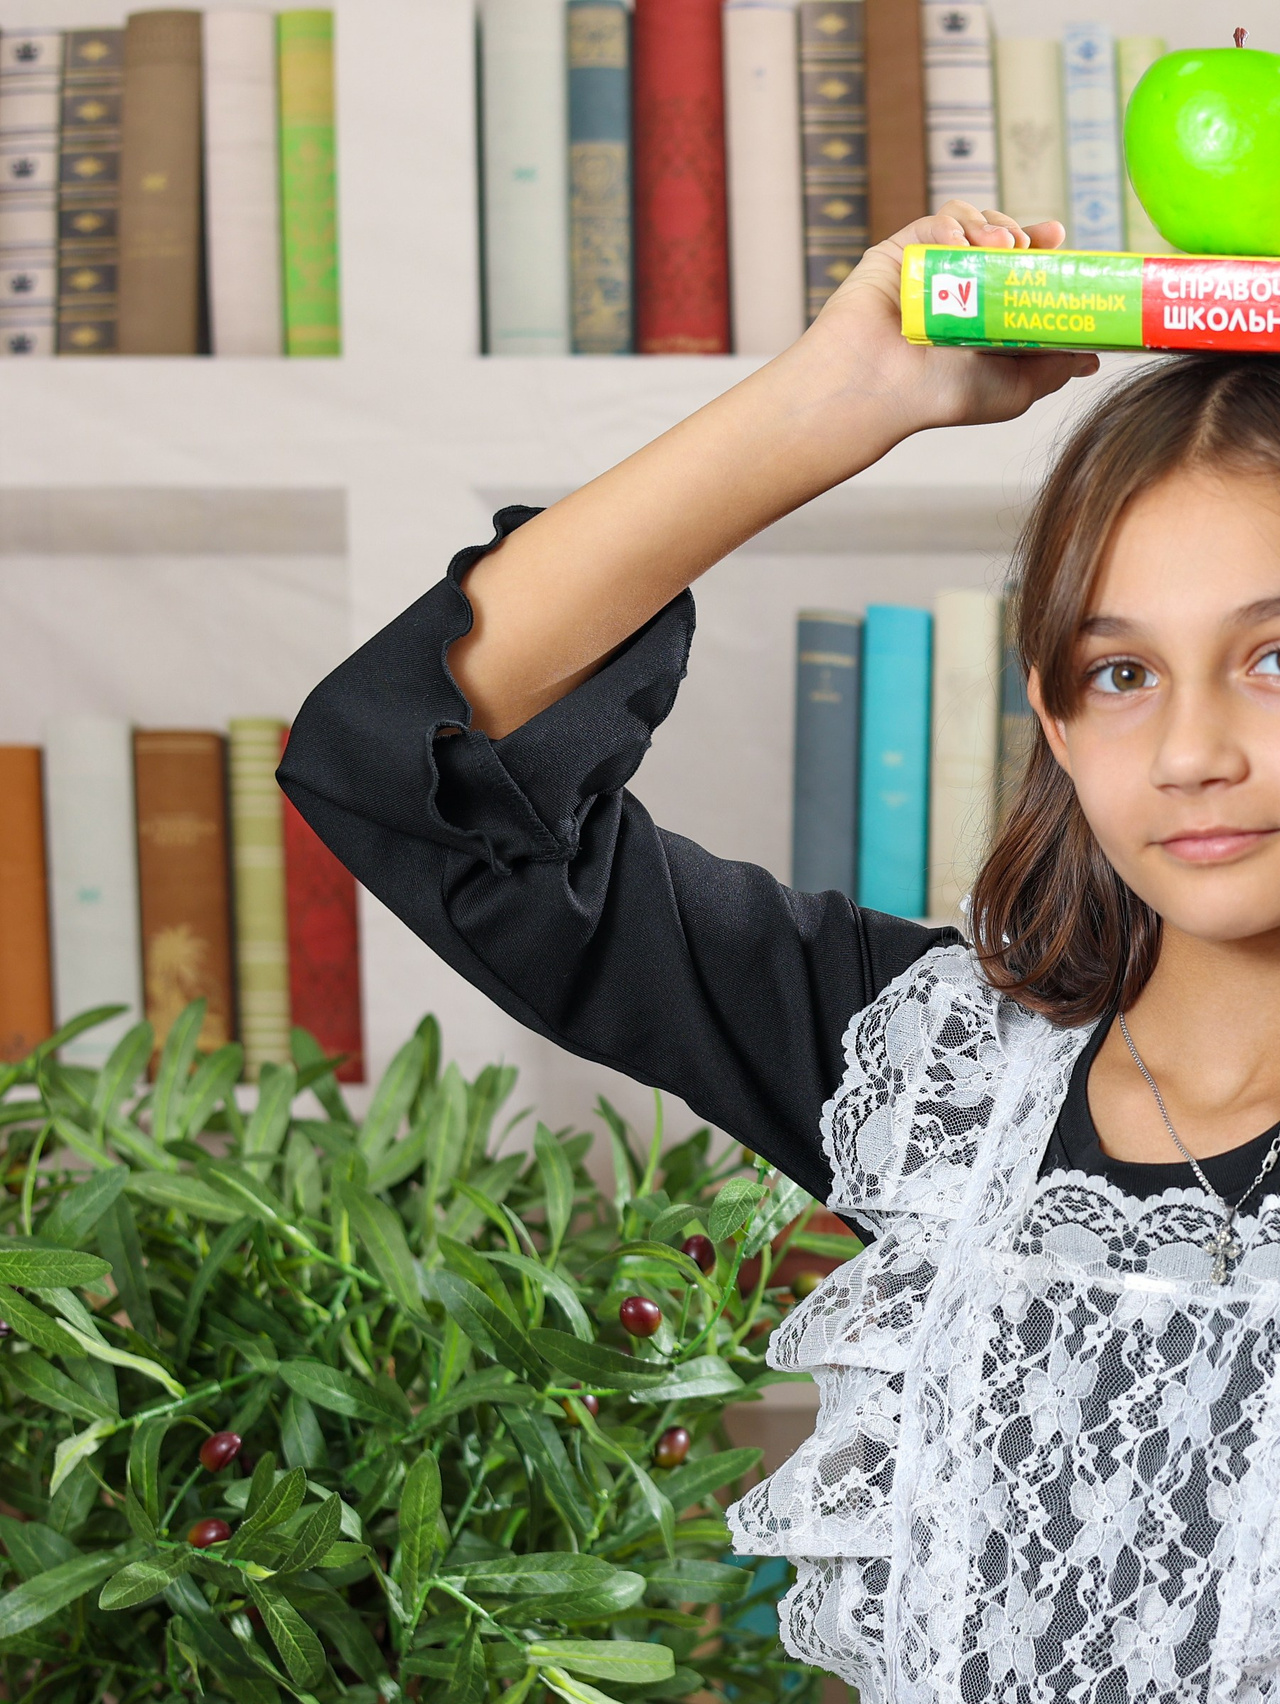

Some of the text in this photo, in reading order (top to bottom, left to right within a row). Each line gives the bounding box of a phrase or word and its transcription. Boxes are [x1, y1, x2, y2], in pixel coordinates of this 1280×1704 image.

[1003, 269, 1047, 287] ДЛЯ
[1003, 289, 1127, 313] НАЧАЛЬНЫХ
[1003, 311, 1097, 332] КЛАССОВ
